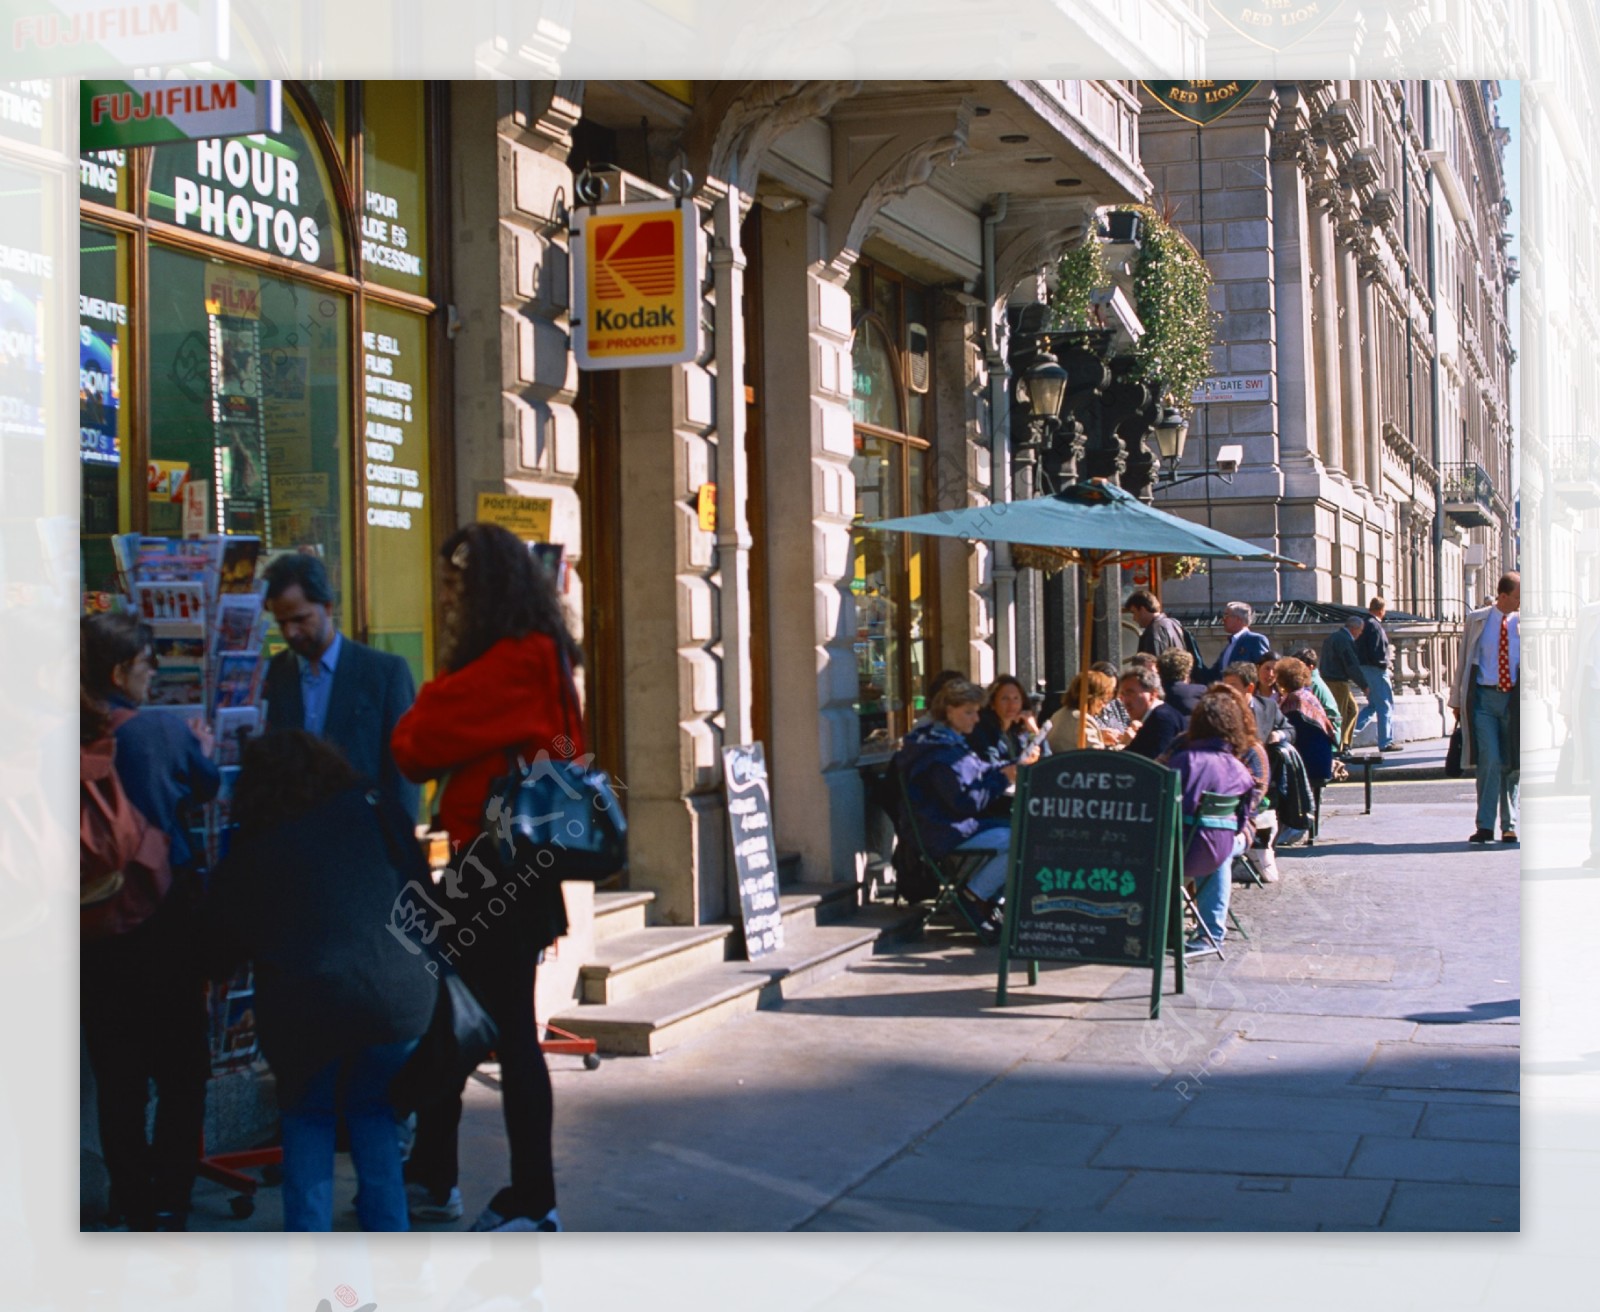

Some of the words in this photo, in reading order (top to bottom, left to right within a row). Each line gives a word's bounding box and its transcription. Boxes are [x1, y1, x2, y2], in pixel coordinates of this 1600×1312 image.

[92, 82, 237, 125] FUJIFILM
[1168, 87, 1198, 104] RED
[1204, 81, 1240, 104] LION
[197, 138, 299, 206] HOUR
[366, 190, 398, 219] HOUR
[175, 176, 320, 263] PHOTOS
[595, 305, 676, 331] Kodak
[606, 335, 677, 349] PRODUCTS
[1220, 380, 1243, 391] GATE
[1245, 379, 1264, 390] SW1
[1056, 771, 1111, 790] CAFE
[1027, 797, 1155, 823] CHURCHILL
[1035, 867, 1137, 897] SNACKS
